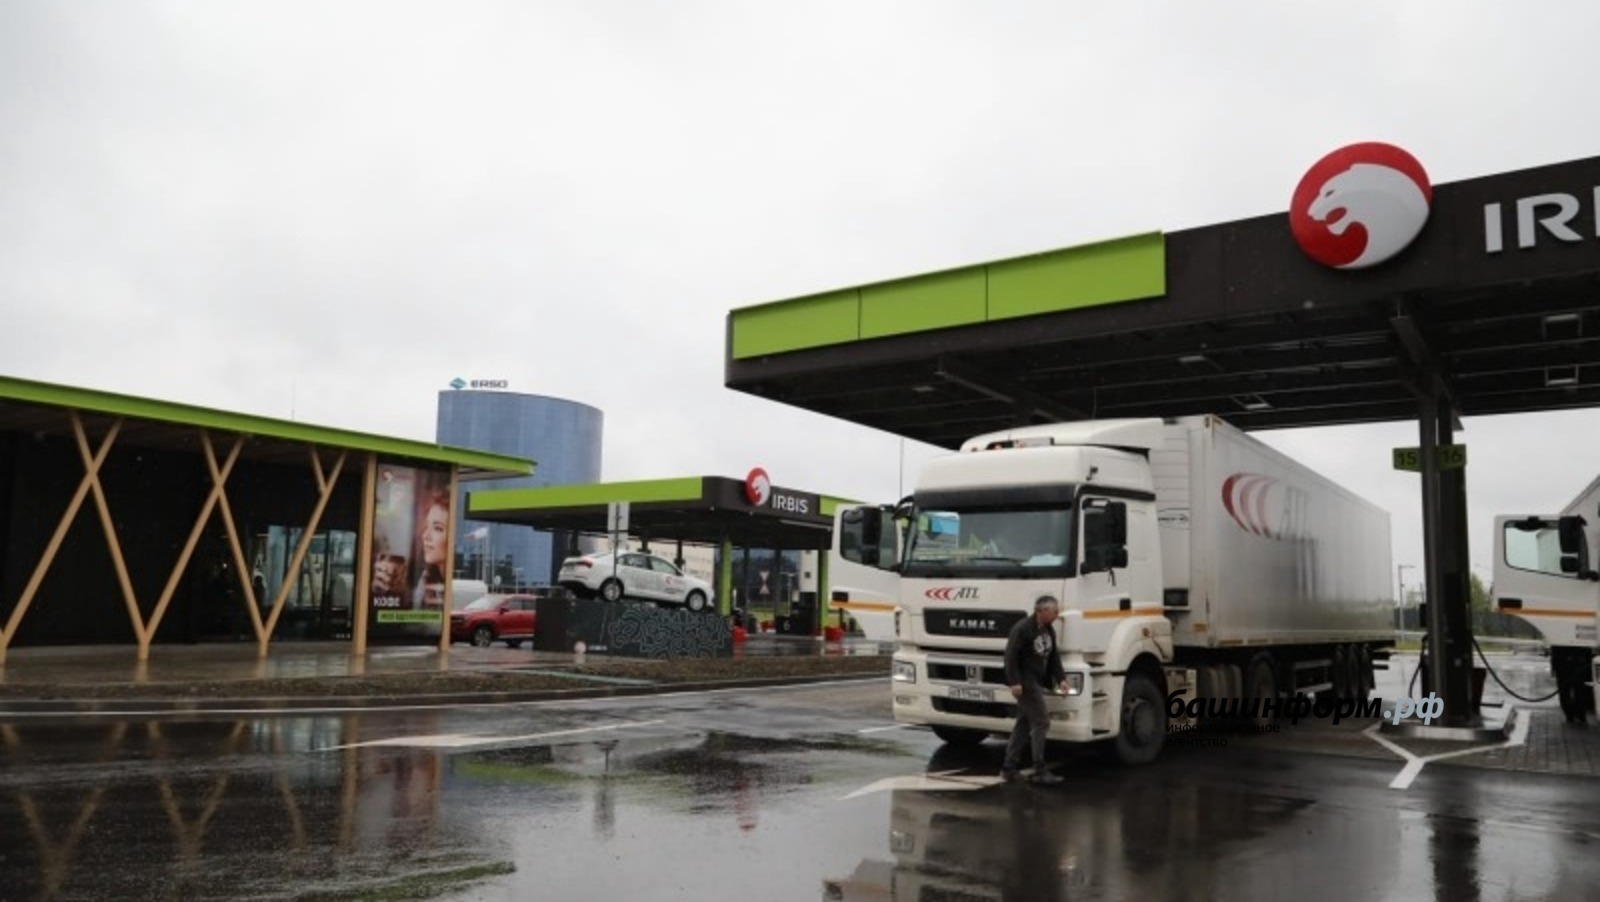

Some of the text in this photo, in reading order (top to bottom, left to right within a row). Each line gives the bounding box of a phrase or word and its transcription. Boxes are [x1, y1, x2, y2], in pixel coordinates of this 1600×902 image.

[1484, 186, 1600, 253] IR
[470, 379, 508, 389] ERSO
[1397, 451, 1417, 466] 15
[1442, 449, 1463, 463] 16
[772, 493, 809, 514] IRBIS
[954, 587, 980, 600] ATL
[783, 620, 791, 630] 6
[950, 619, 997, 630] KAMAZ
